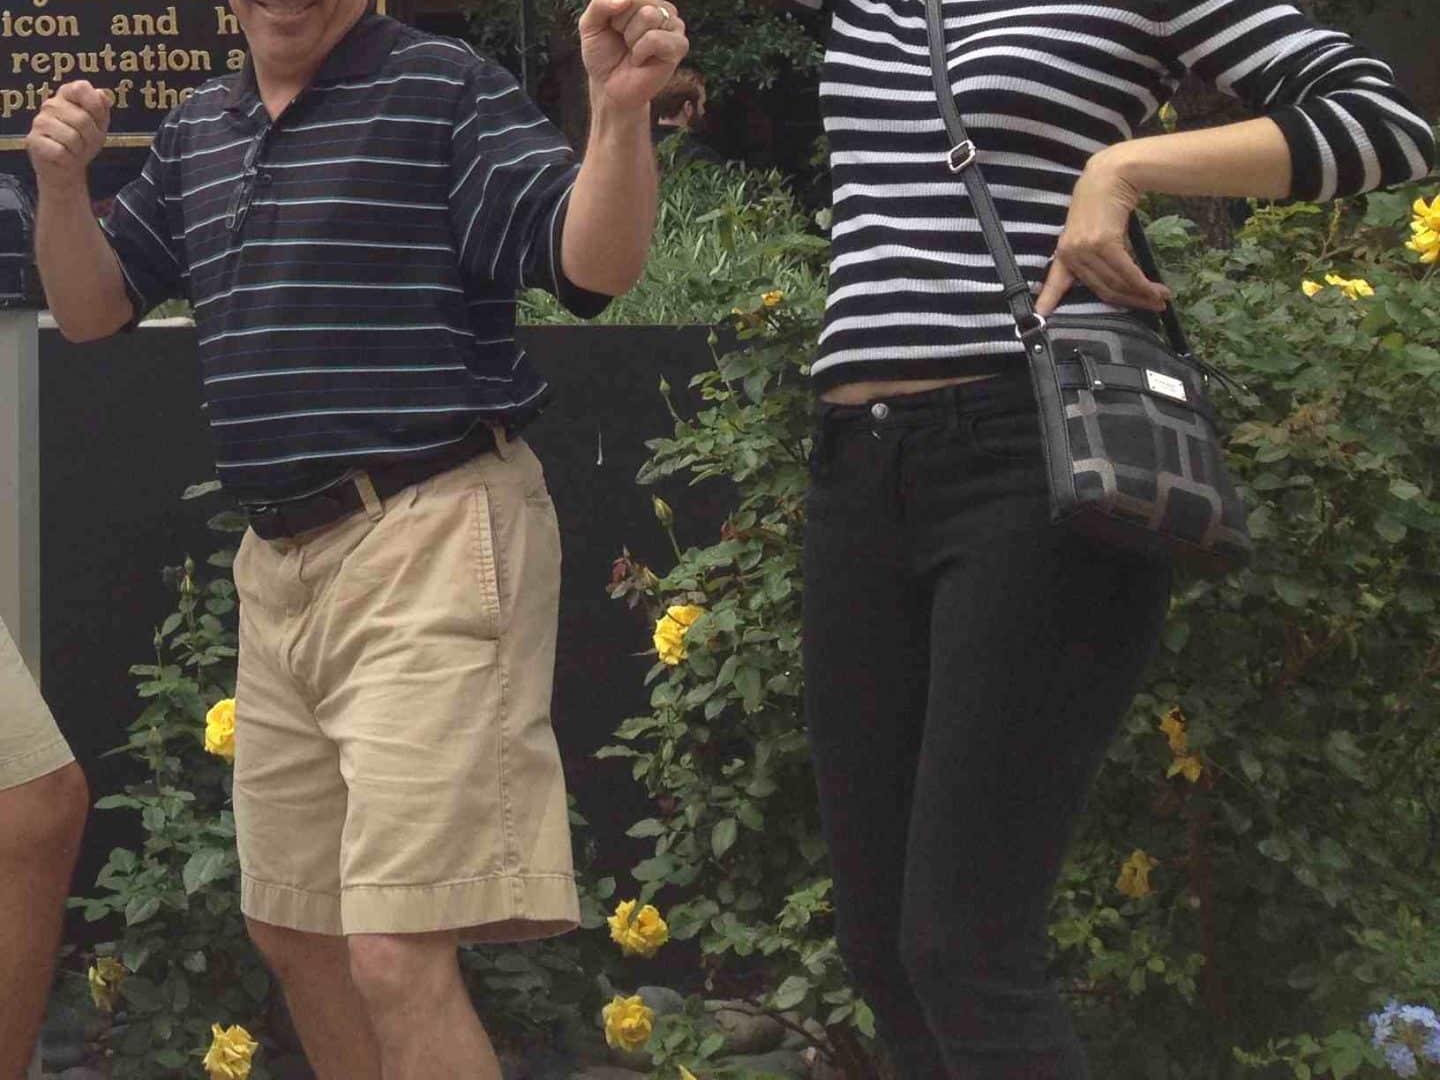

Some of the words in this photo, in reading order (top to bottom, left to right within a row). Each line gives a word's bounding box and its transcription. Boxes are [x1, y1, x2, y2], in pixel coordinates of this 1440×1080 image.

[1, 9, 80, 38] icon
[111, 6, 179, 36] and
[11, 42, 212, 82] reputation
[226, 48, 246, 70] a
